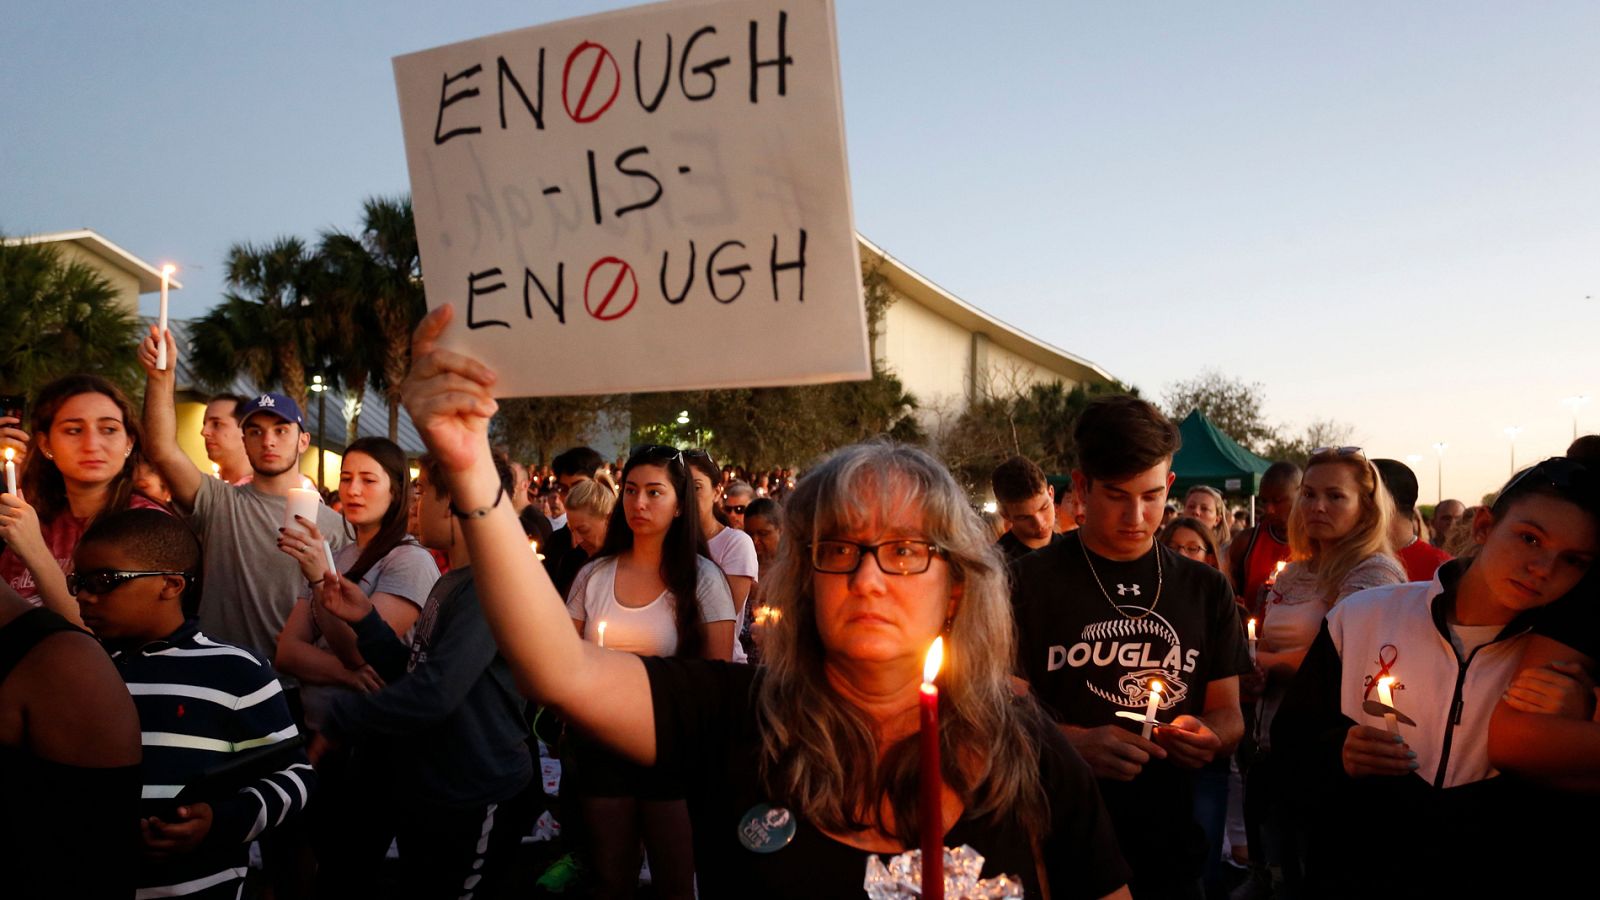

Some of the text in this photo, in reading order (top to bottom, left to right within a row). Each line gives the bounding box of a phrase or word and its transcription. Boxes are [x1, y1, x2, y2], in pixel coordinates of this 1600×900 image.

[434, 10, 794, 145] ENOUGH
[466, 228, 807, 330] ENOUGH
[258, 394, 275, 407] LA
[1047, 641, 1200, 674] DOUGLAS
